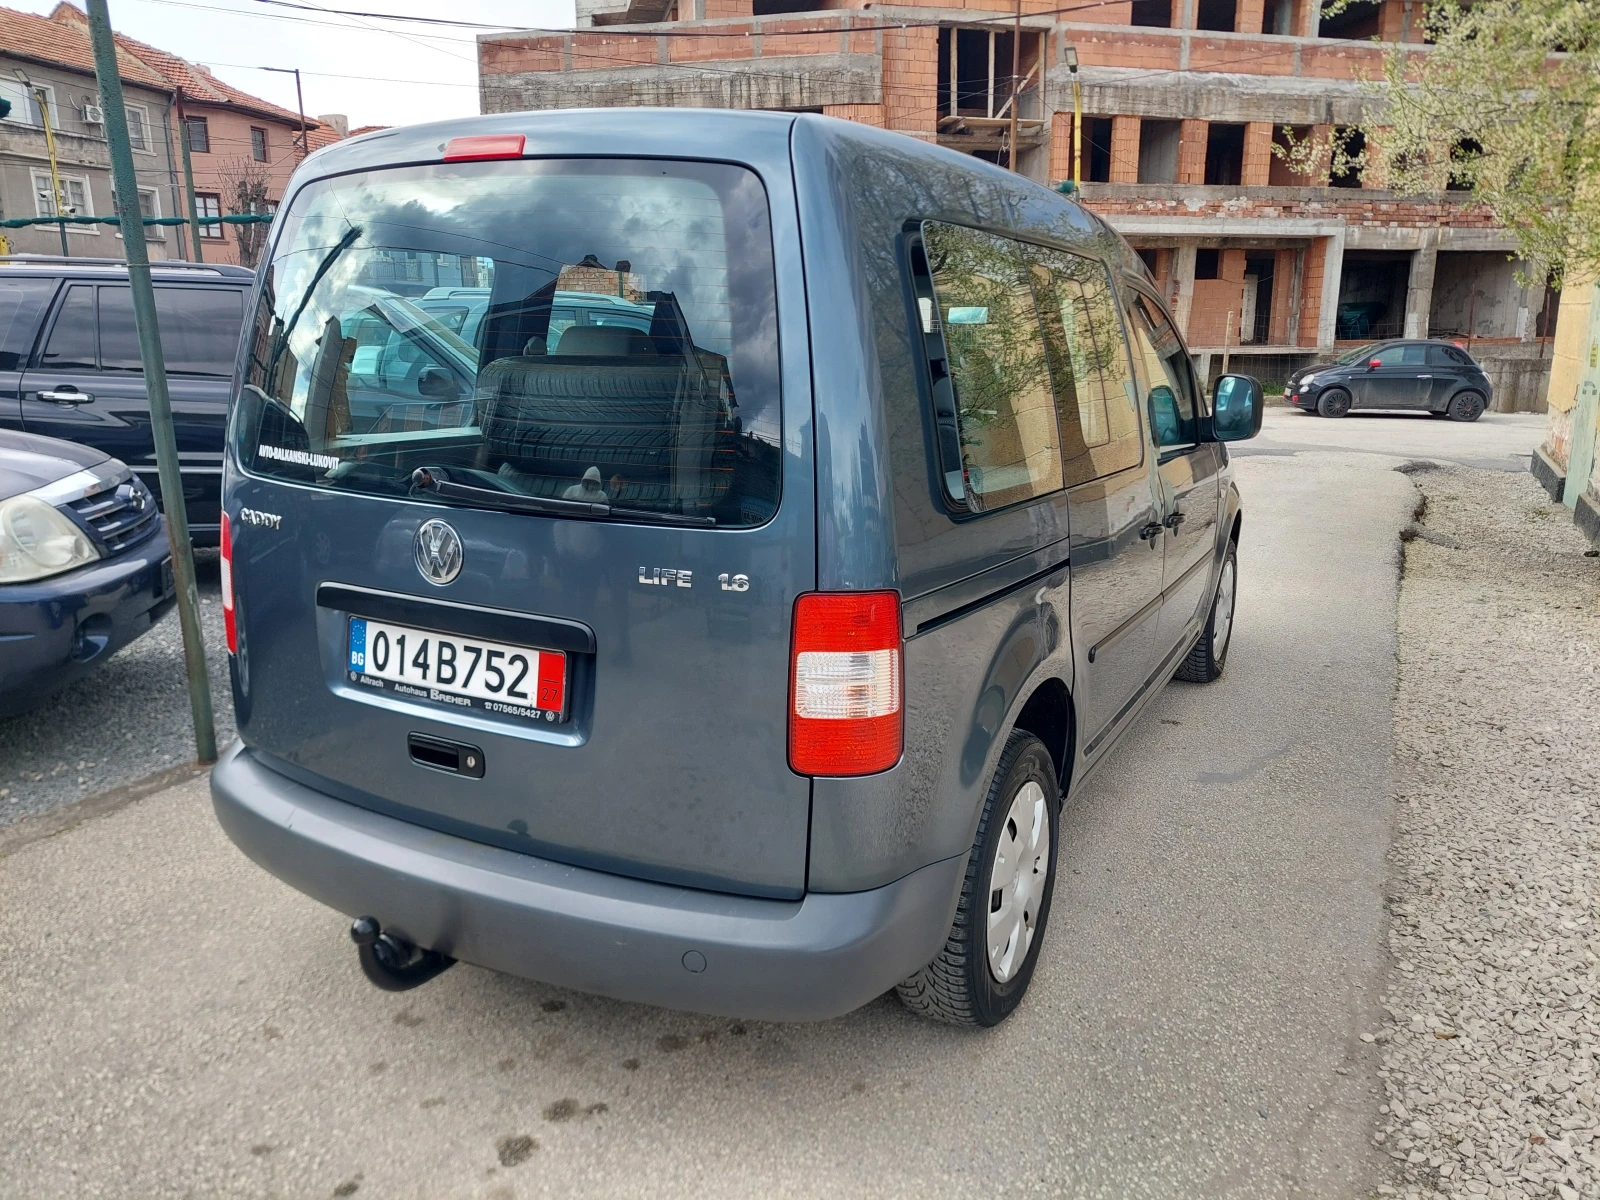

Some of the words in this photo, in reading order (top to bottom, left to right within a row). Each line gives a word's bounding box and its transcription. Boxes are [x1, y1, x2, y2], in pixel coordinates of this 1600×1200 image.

[258, 444, 339, 470] AVTO-BALKANSKI-LUKOVIT
[240, 507, 282, 530] CADDY
[638, 566, 693, 588] LIFE
[351, 651, 365, 666] BG
[372, 630, 529, 700] 014B752
[394, 683, 428, 698] Autohaus
[541, 687, 558, 702] 27
[493, 702, 541, 719] 07565/5427
